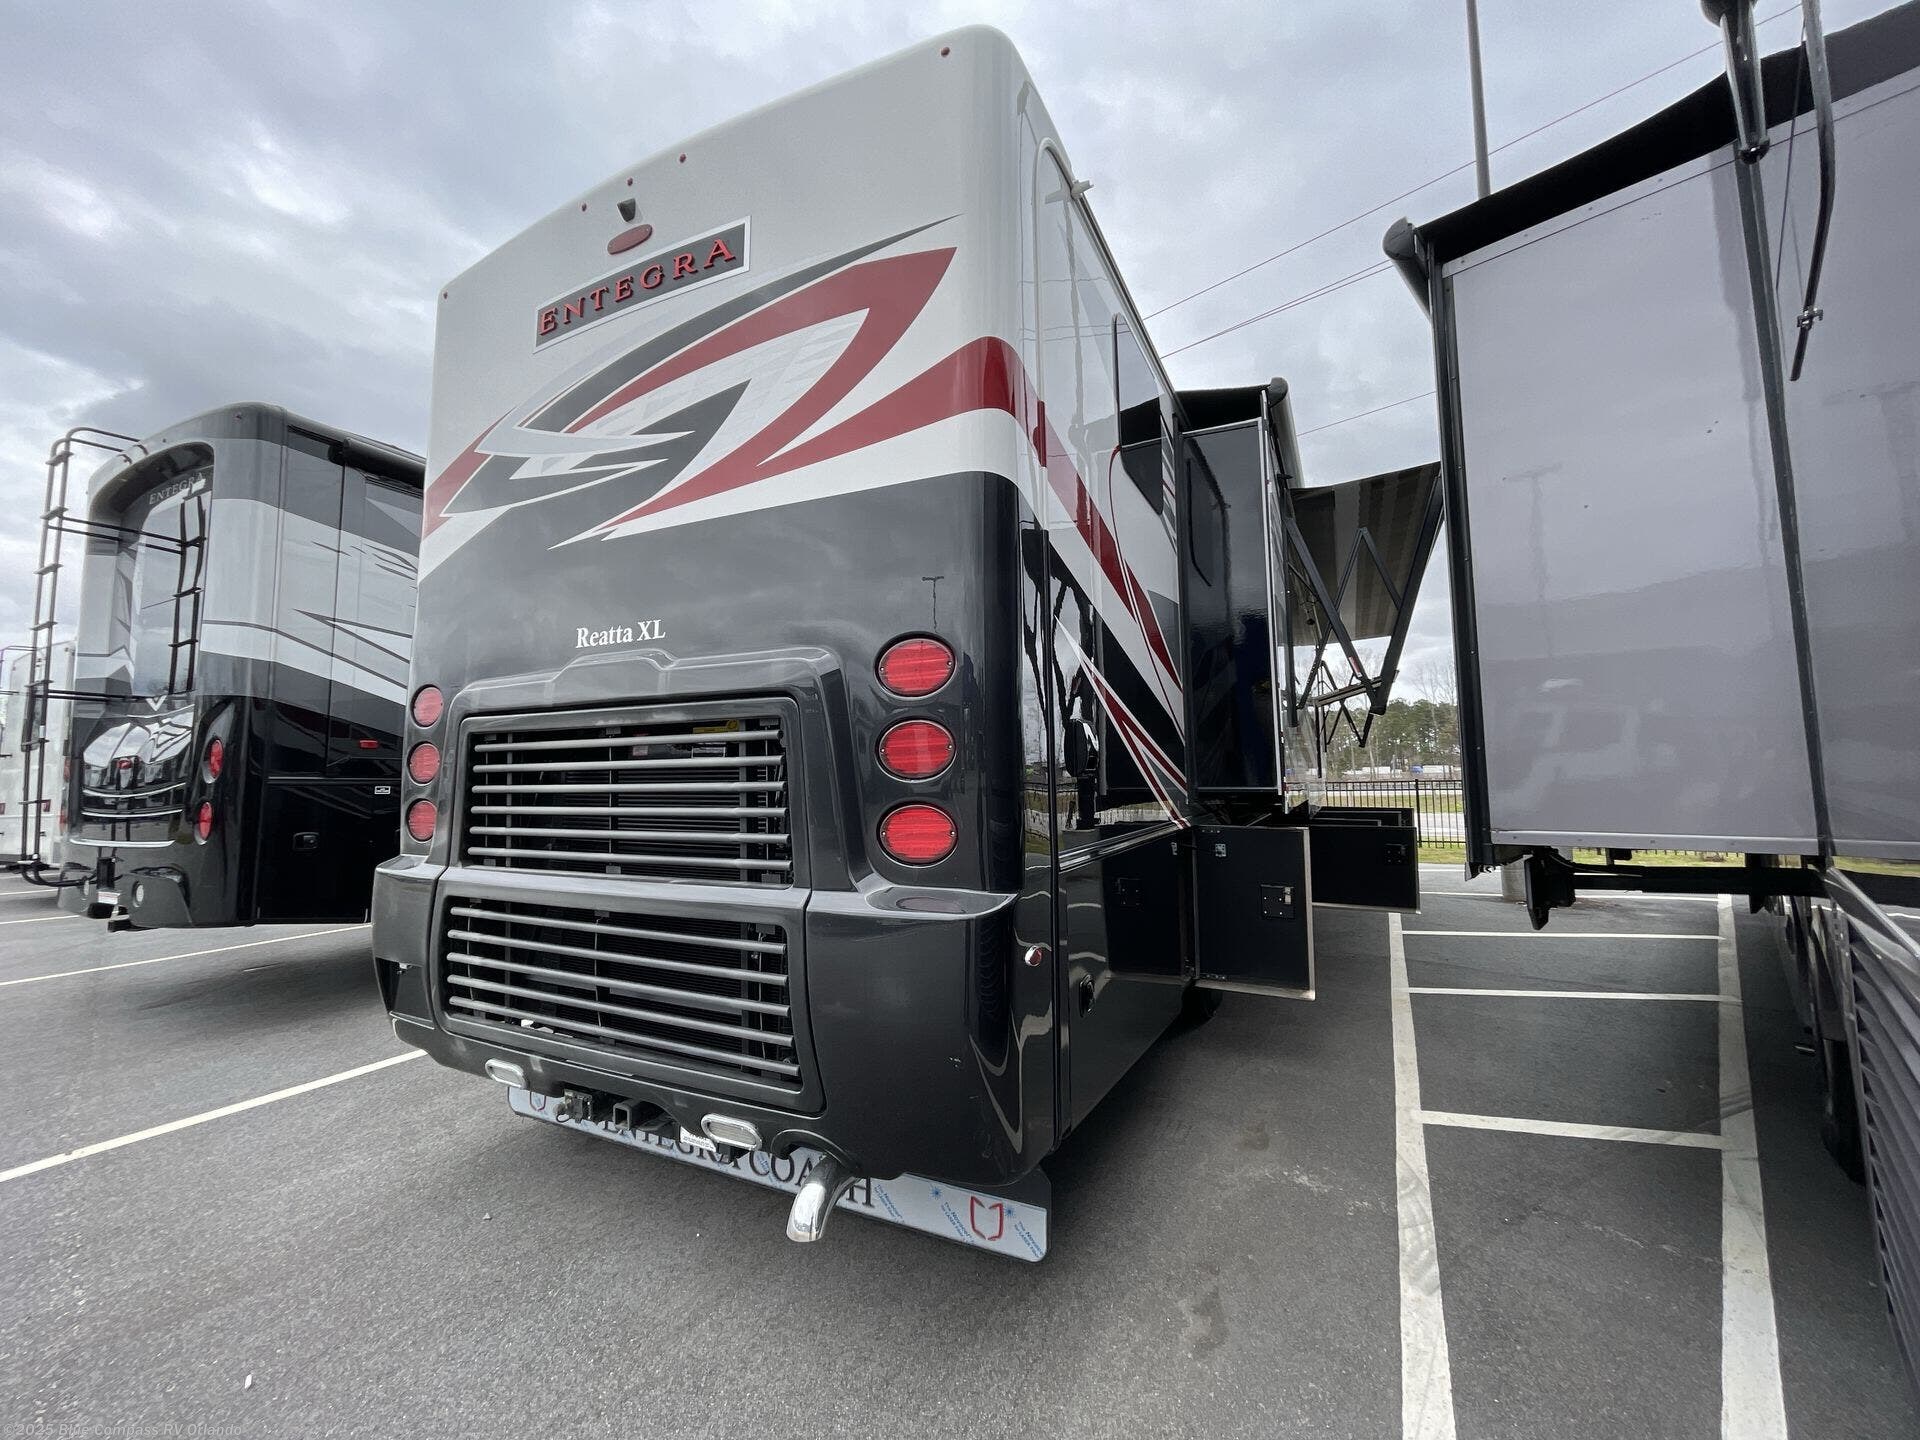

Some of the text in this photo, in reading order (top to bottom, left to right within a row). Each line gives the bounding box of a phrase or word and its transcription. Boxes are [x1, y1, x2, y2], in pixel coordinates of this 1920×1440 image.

[540, 238, 736, 336] ENTEGRA
[149, 472, 203, 504] ENTEGRA
[575, 619, 666, 648] Reatta XL
[749, 1150, 875, 1207] COAH
